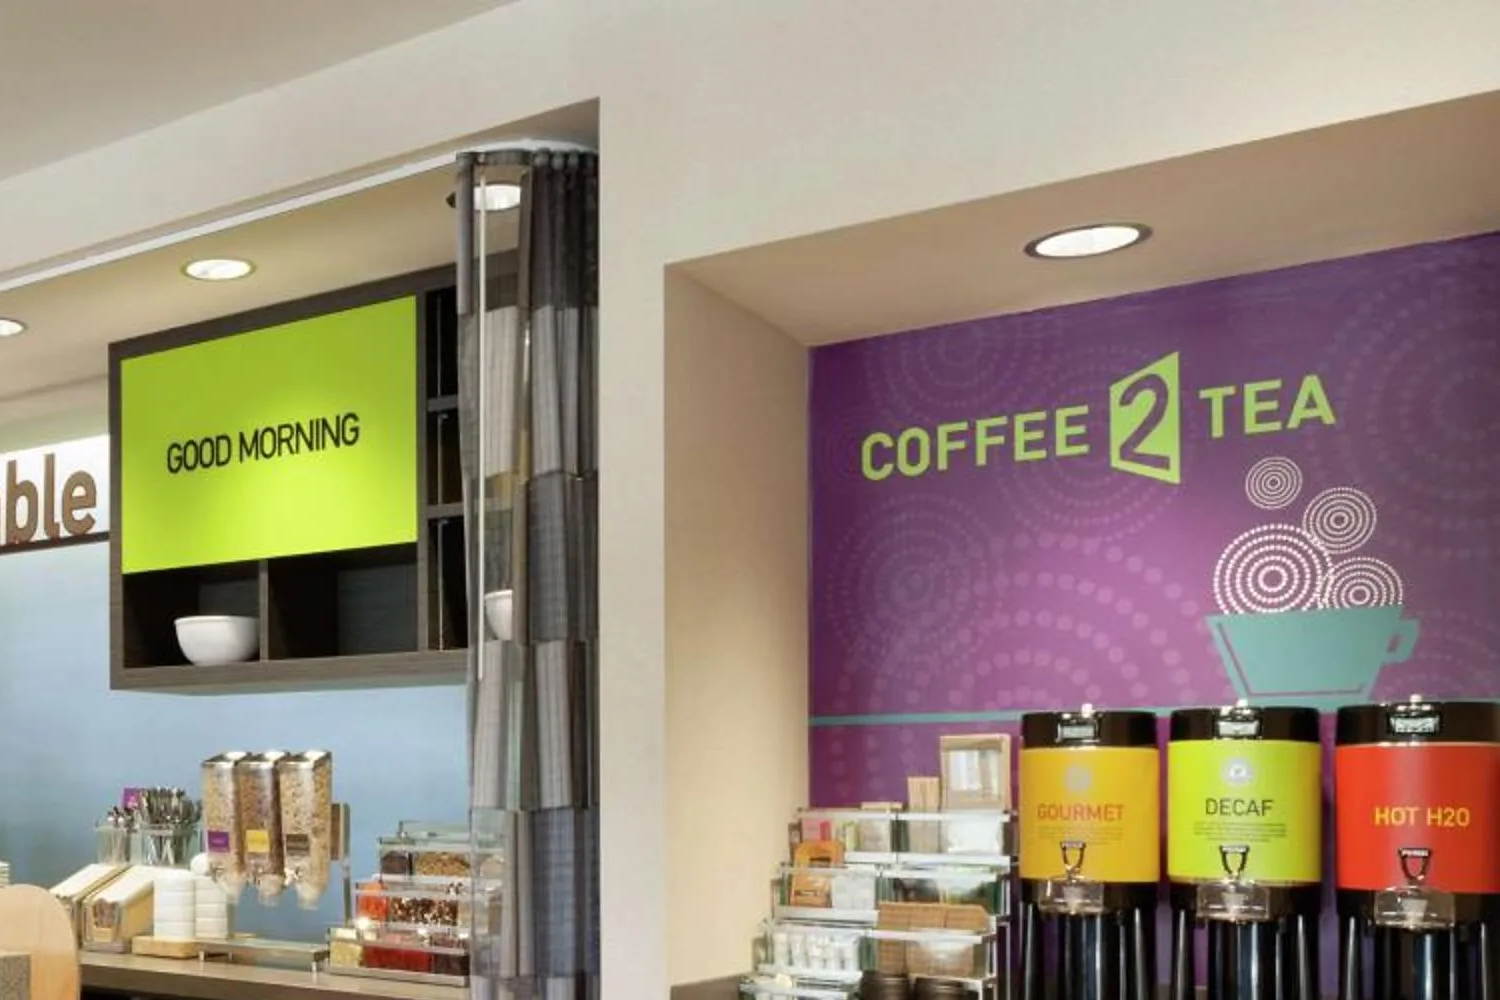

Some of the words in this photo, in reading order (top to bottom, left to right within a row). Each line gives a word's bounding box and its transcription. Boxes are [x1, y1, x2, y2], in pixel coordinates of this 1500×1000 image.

[861, 405, 1090, 481] COFFEE
[1113, 361, 1176, 478] 2
[1199, 375, 1336, 438] TEA
[167, 434, 233, 474] GOOD
[238, 412, 361, 464] MORNING
[1037, 803, 1125, 822] GOURMET
[1205, 798, 1275, 817] DECAF
[1374, 806, 1420, 827] HOT
